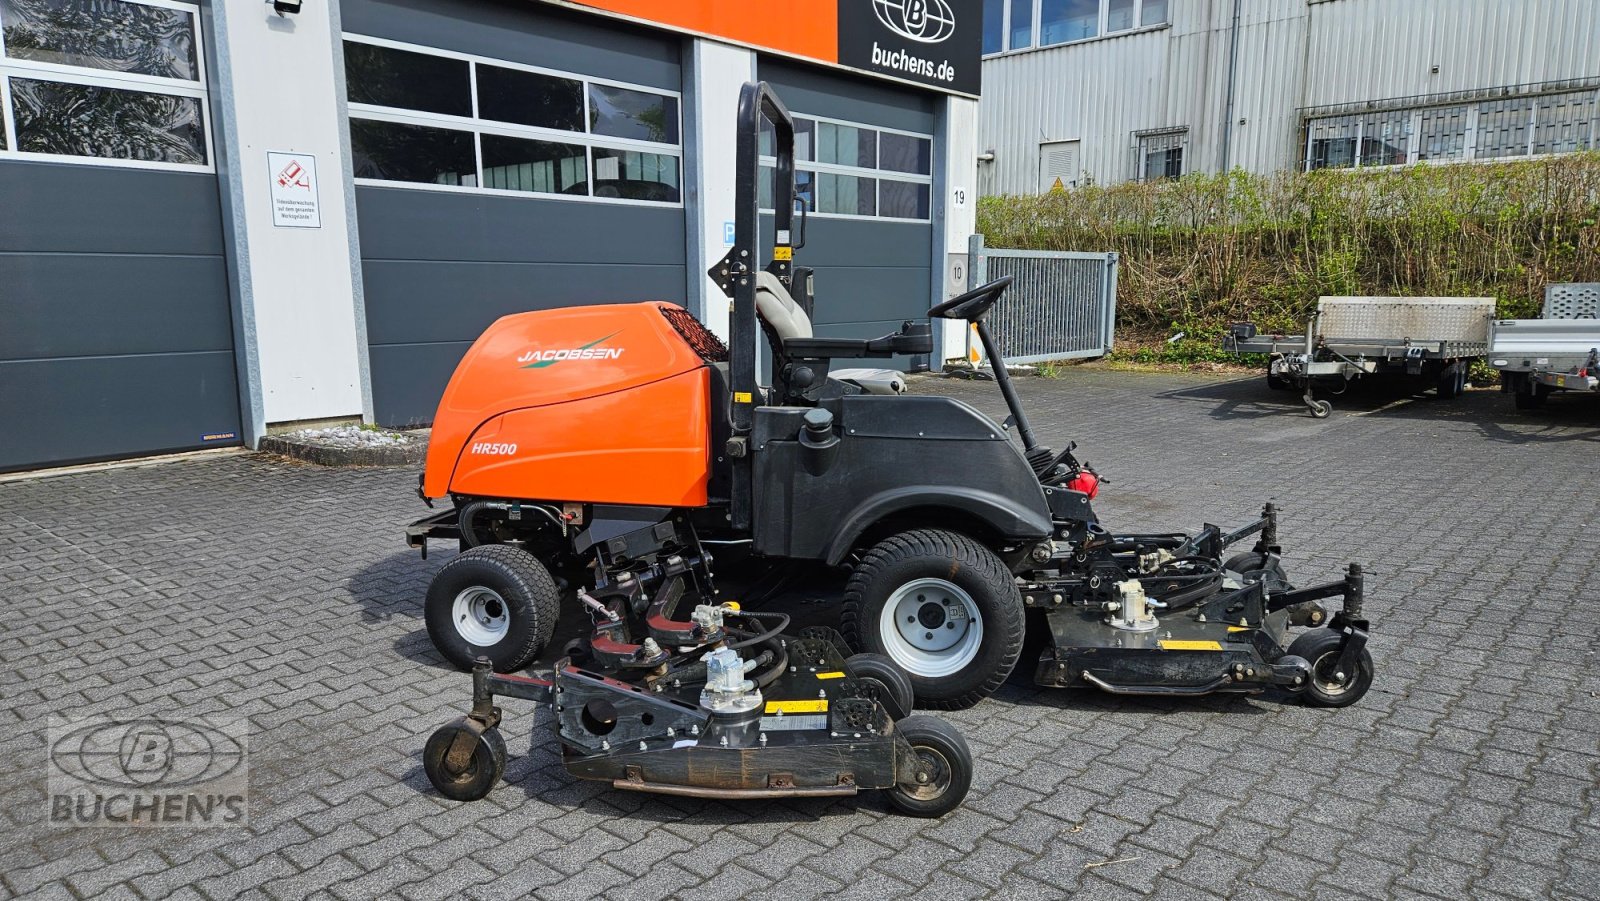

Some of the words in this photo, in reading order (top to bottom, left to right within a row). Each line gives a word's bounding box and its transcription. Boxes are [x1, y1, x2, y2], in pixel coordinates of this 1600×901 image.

[872, 41, 955, 82] buchens.de
[954, 190, 965, 205] 19
[725, 224, 735, 241] P
[953, 267, 962, 280] 10
[517, 348, 622, 363] JACOBSEN
[471, 442, 517, 455] HR500
